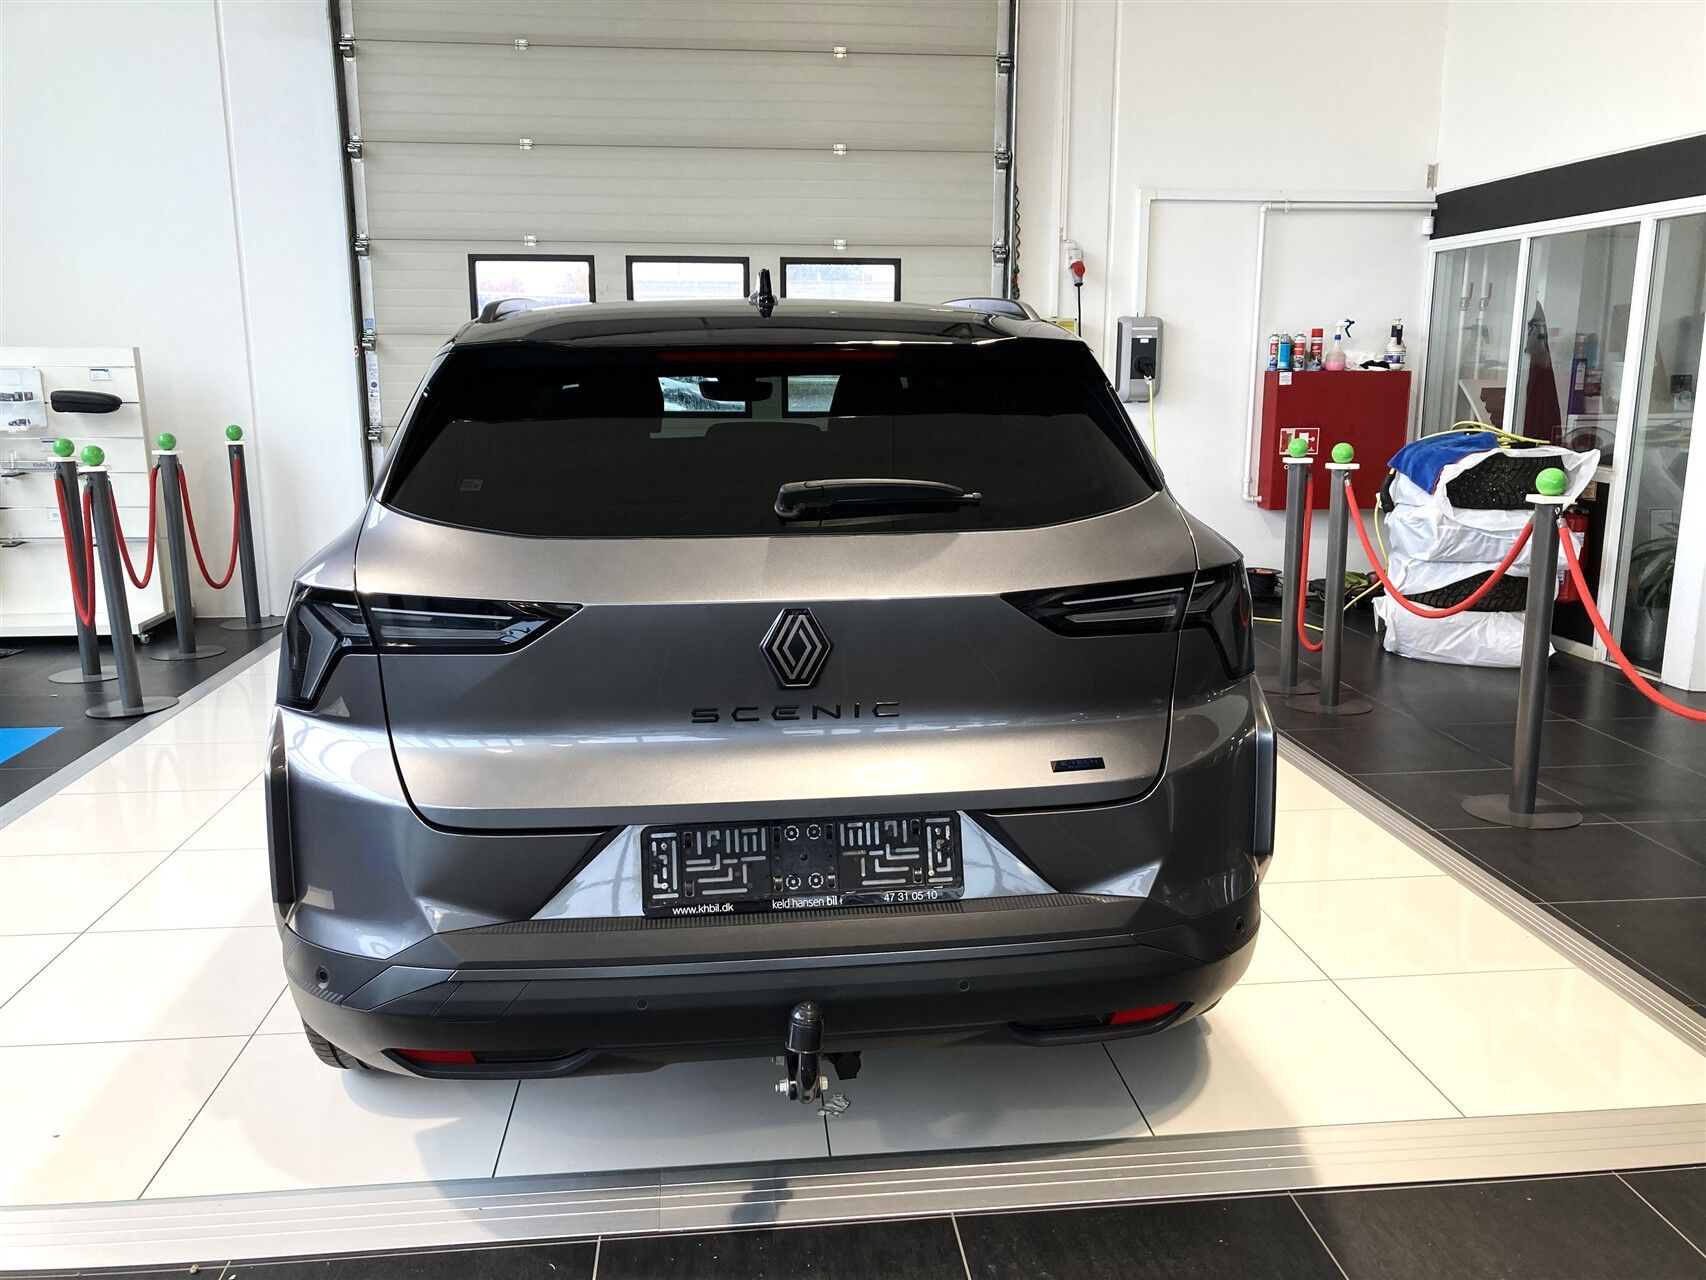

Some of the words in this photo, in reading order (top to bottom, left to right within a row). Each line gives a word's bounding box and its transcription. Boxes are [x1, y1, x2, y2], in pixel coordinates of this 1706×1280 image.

[691, 702, 900, 723] SCENIC
[772, 898, 790, 909] keld
[792, 898, 825, 908] hansen
[826, 895, 838, 906] bil
[884, 893, 895, 902] 47
[897, 892, 909, 902] 31
[911, 891, 924, 901] 05
[926, 890, 938, 900] 10
[672, 903, 734, 915] www.khbil.dk
